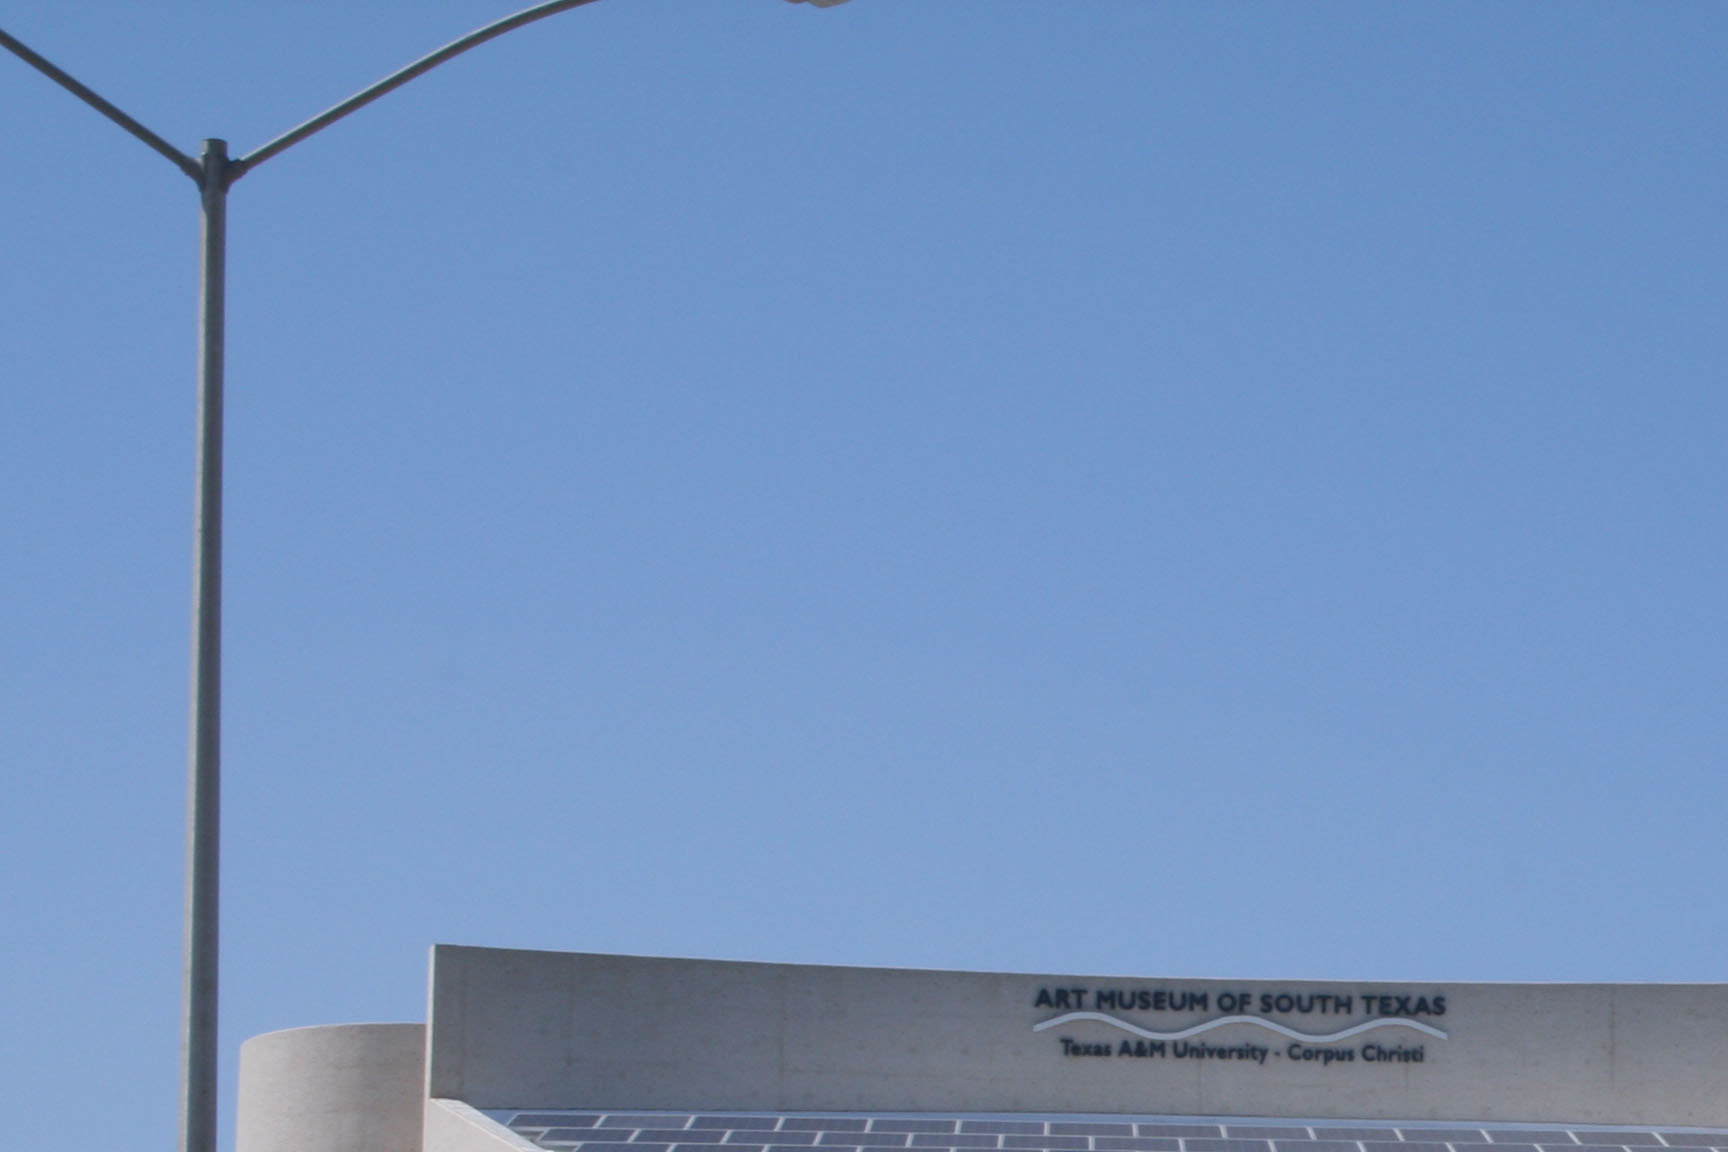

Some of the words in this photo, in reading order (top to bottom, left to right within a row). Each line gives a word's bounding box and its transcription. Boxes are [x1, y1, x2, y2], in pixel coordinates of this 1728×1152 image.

[1034, 988, 1088, 1010] ART
[1095, 989, 1208, 1013] MUSEUM
[1217, 993, 1252, 1013] OF
[1259, 994, 1353, 1015] SOUTH
[1360, 995, 1446, 1017] TEXAS
[1060, 1038, 1112, 1058] Texas
[1118, 1040, 1166, 1059] A&M
[1173, 1041, 1269, 1065] University
[1287, 1044, 1355, 1065] Corpus
[1361, 1044, 1424, 1064] Christi
